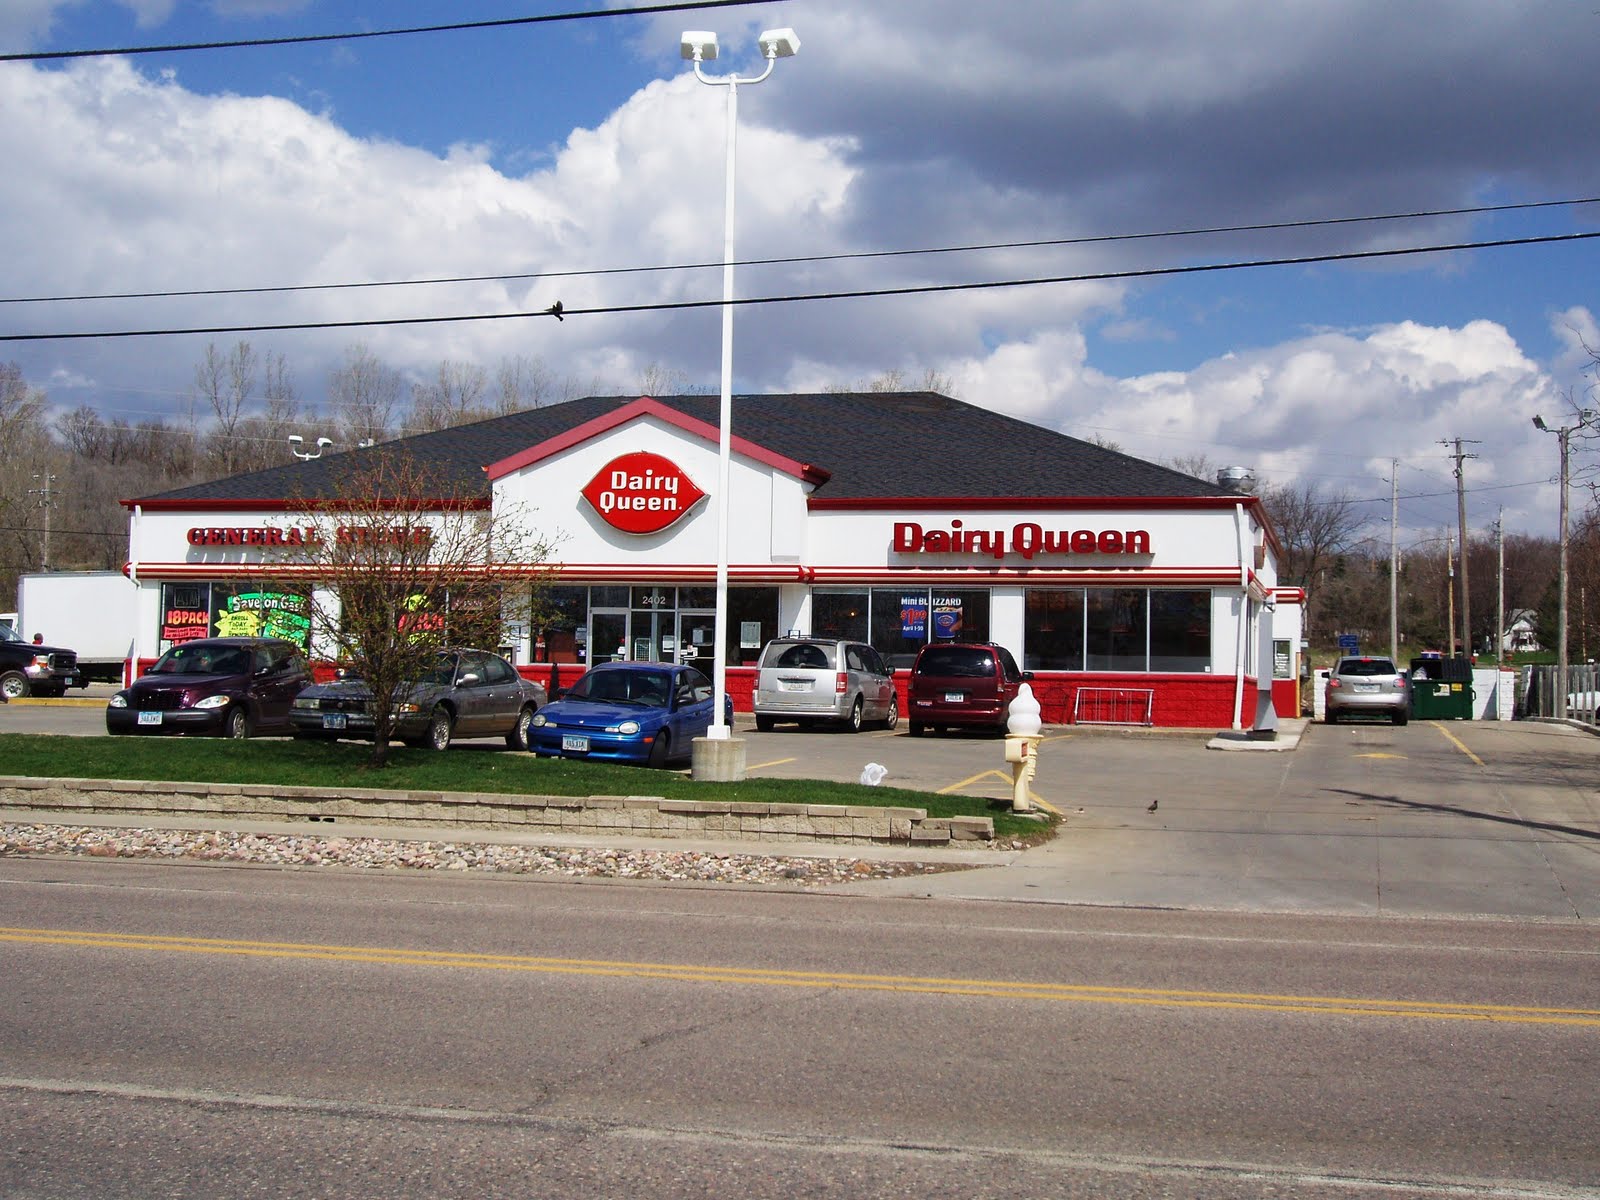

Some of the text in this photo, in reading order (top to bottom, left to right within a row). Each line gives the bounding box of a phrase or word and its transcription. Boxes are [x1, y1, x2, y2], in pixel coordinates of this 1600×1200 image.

[611, 469, 678, 495] Dairy
[187, 527, 324, 546] GENERAL
[893, 519, 1150, 560] Dairy Queen
[232, 596, 260, 611] Save
[264, 599, 278, 609] on
[642, 596, 666, 605] 2402
[901, 596, 917, 606] Mini
